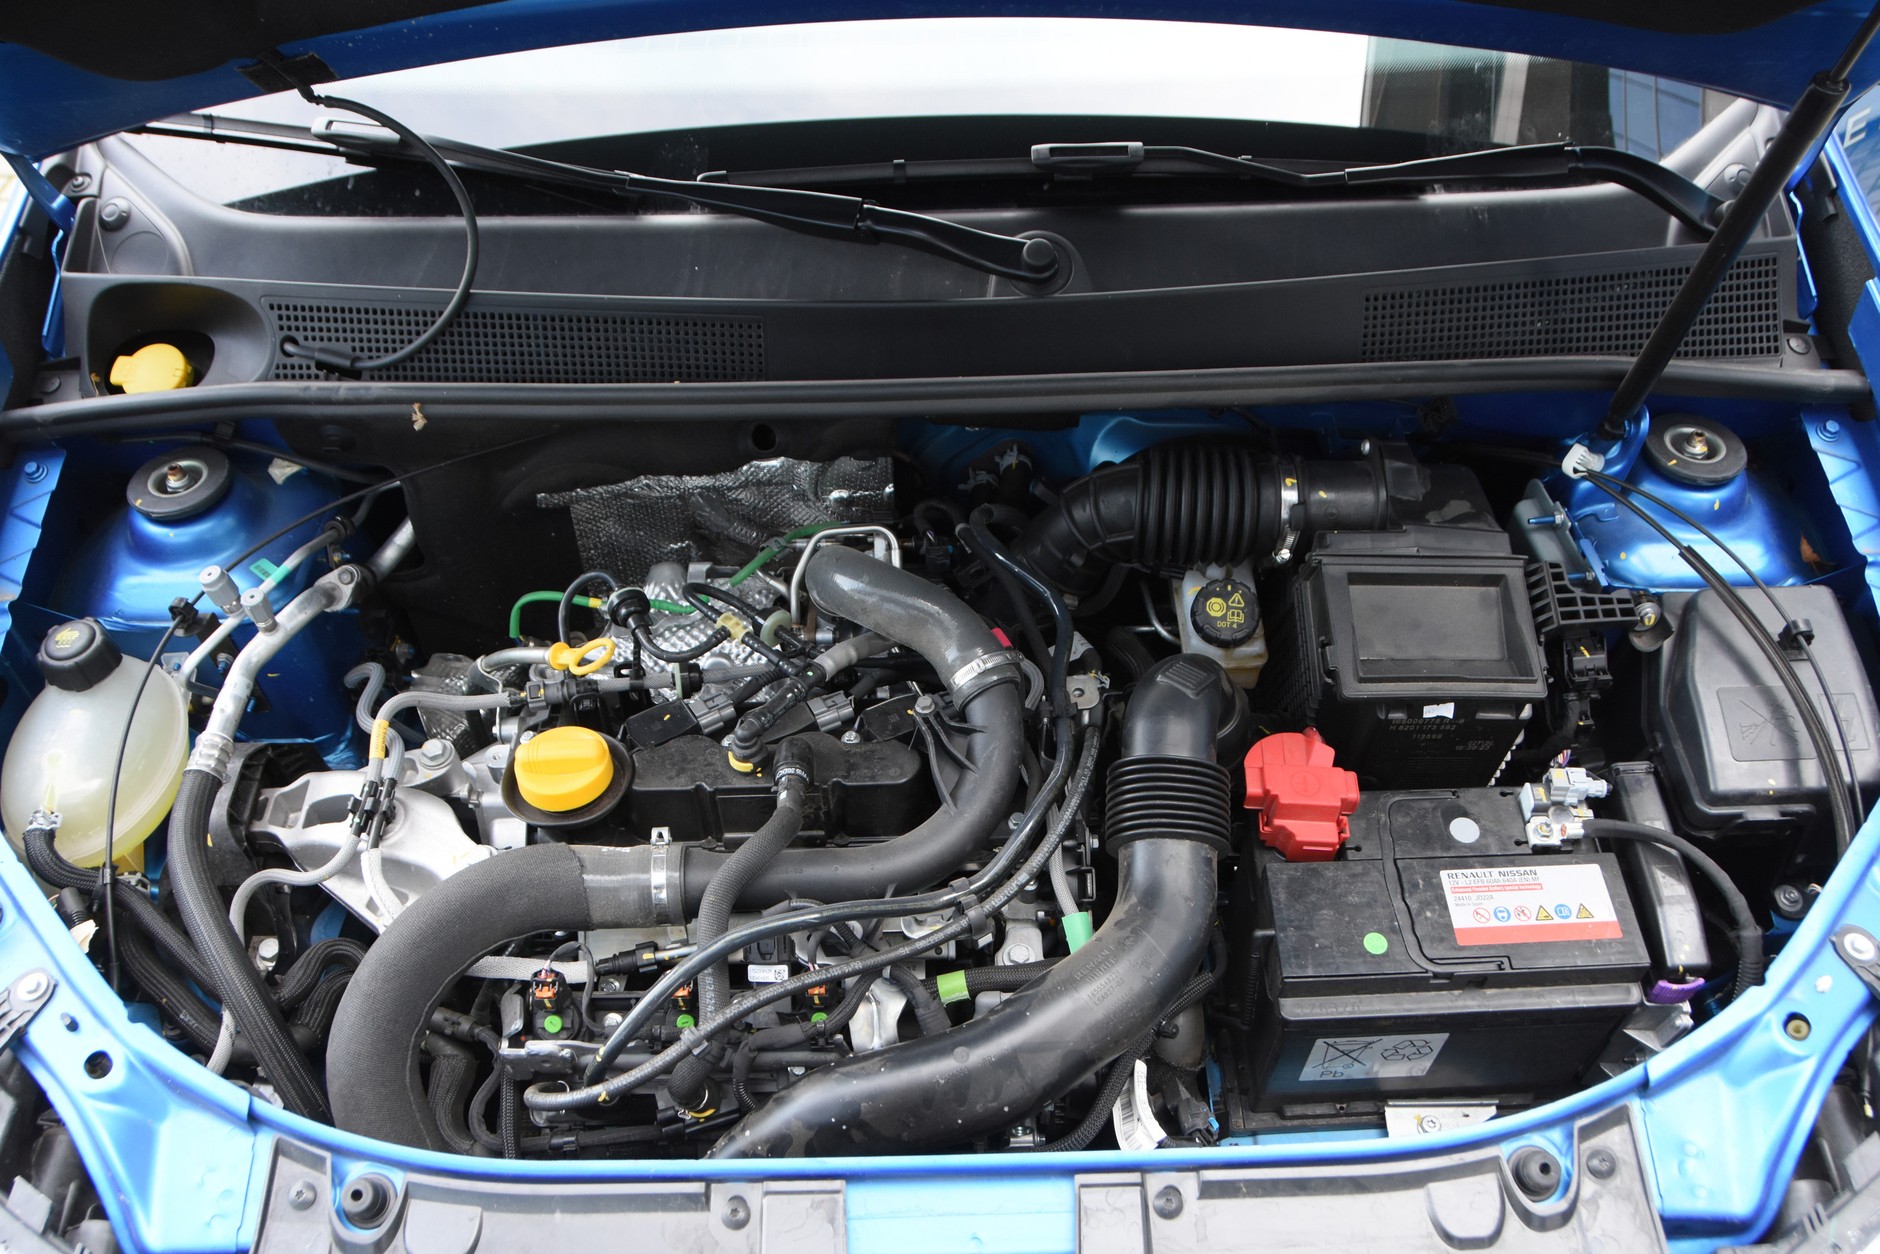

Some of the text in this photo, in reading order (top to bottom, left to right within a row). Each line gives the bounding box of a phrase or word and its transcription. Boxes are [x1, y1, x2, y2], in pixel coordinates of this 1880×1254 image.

[1447, 869, 1538, 880] RENAULT NISSAN
[1319, 1070, 1345, 1079] Pb
